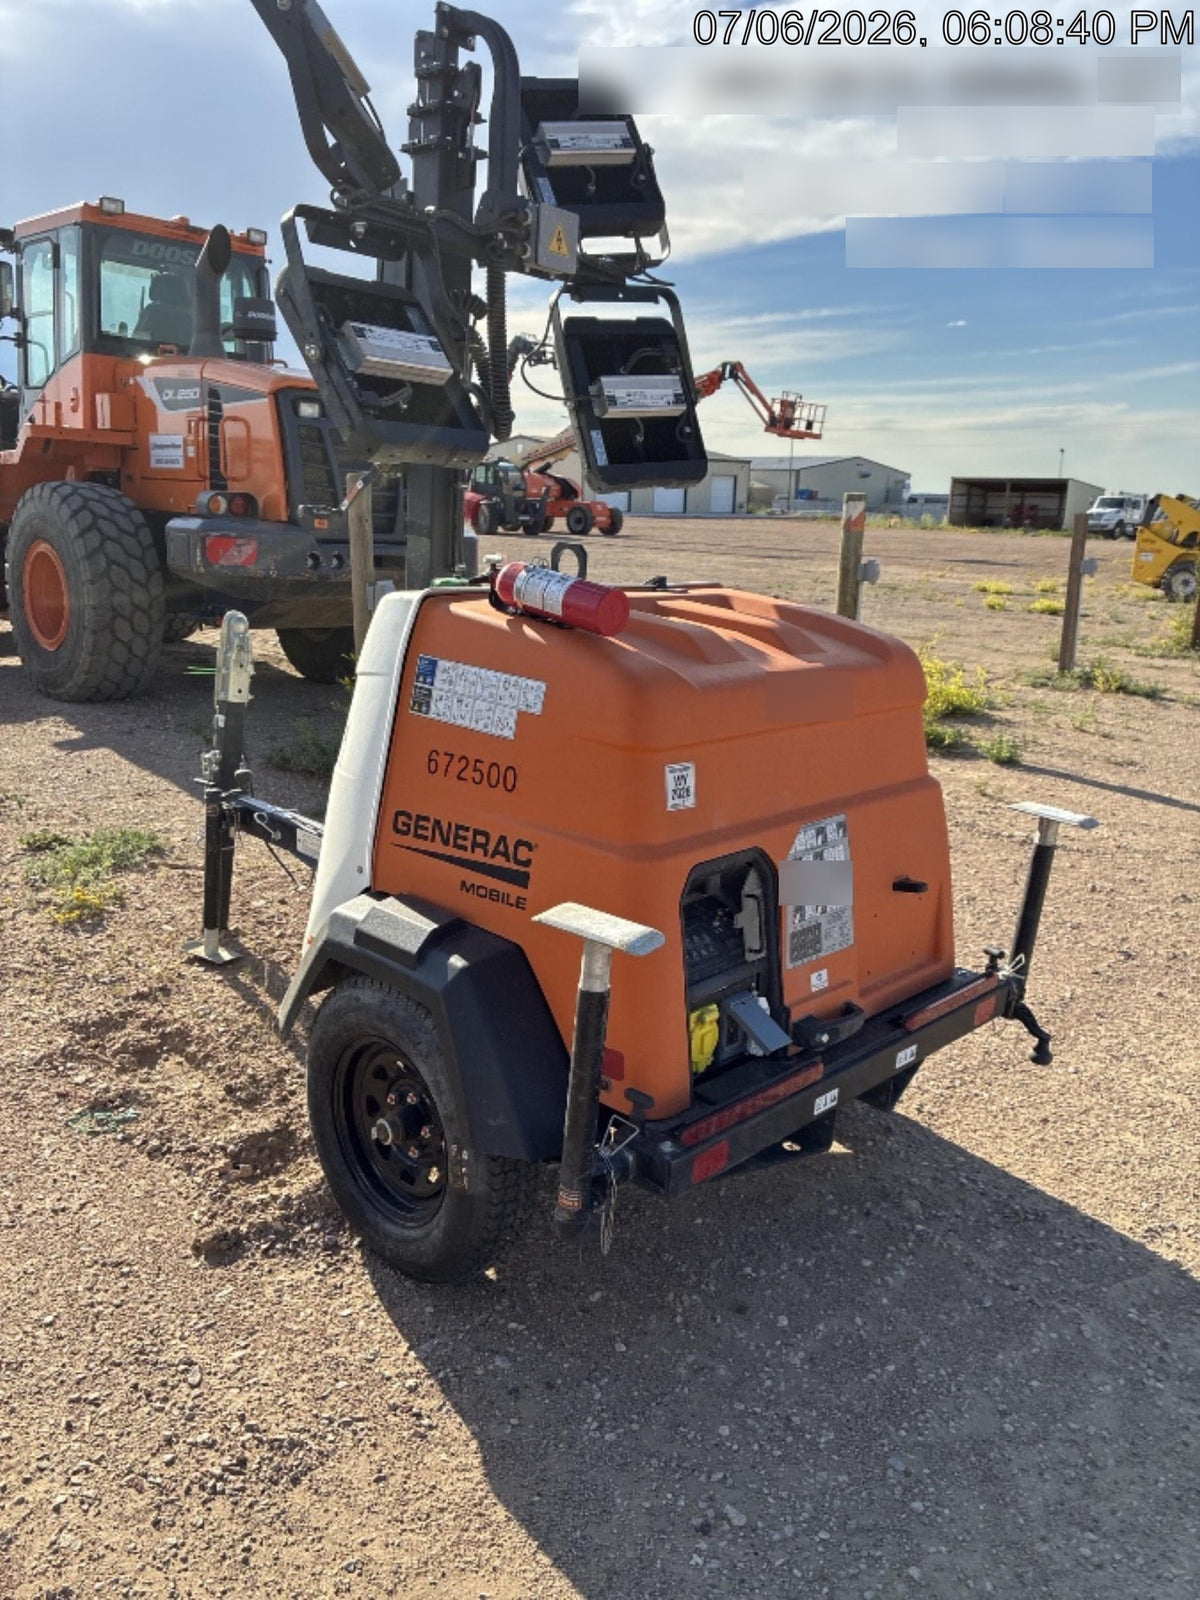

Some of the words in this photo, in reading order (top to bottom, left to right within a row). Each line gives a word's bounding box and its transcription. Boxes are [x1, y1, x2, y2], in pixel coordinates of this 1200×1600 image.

[130, 239, 196, 266] DOOS
[427, 749, 518, 793] 672500
[391, 809, 535, 868] GENERAC
[459, 879, 528, 911] MOBILE
